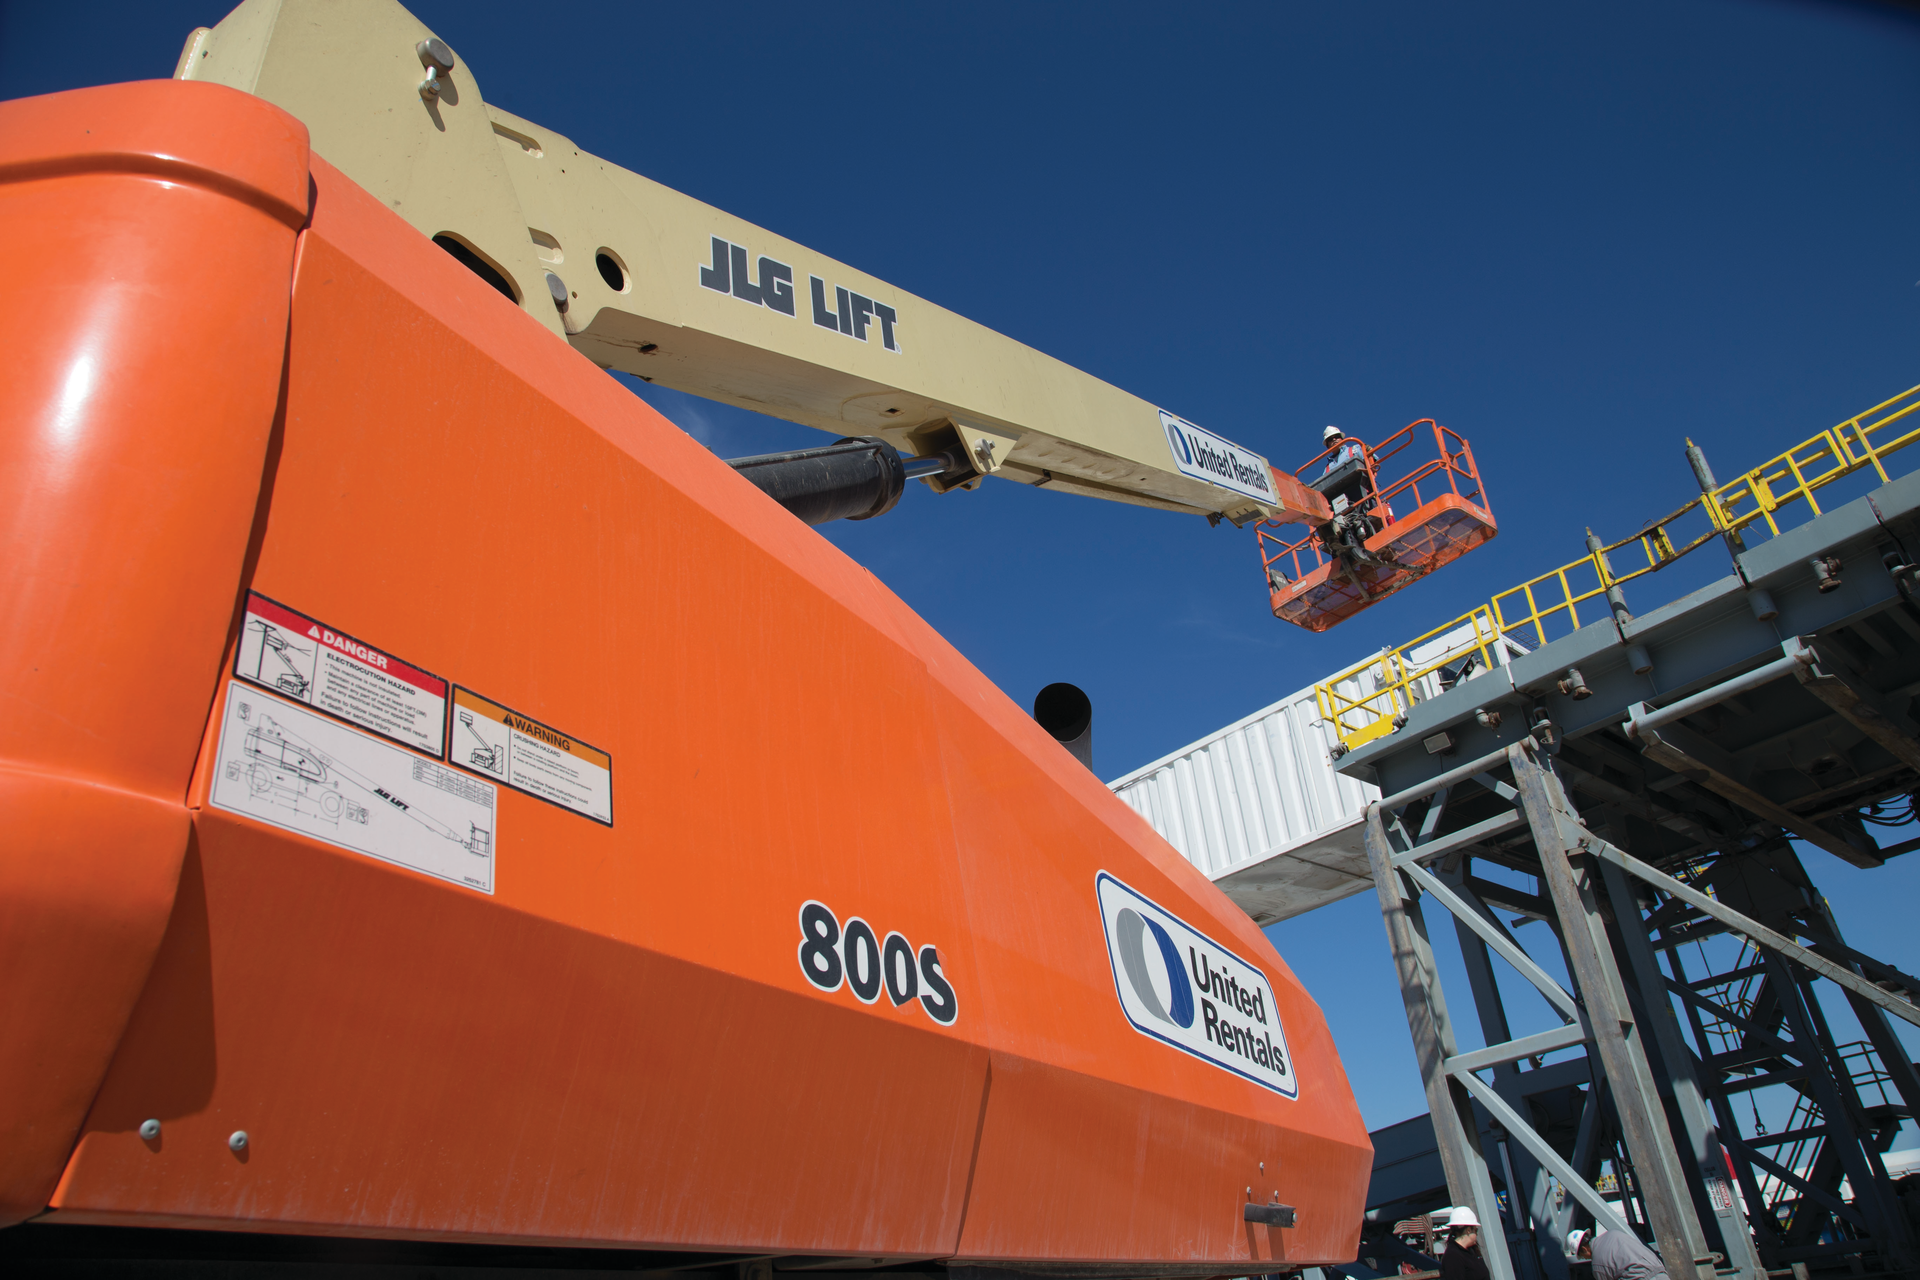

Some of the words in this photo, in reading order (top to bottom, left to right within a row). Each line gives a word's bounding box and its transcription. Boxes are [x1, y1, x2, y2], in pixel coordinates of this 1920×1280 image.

[699, 233, 796, 319] JLG
[809, 273, 898, 353] LIFT
[1187, 433, 1234, 480] United
[1229, 451, 1269, 493] Rentals
[323, 630, 387, 670] DANGER
[327, 652, 386, 683] ELECTROCUTION
[388, 679, 416, 696] HAZARD
[321, 691, 341, 704] Failure
[350, 703, 368, 715] follow
[368, 710, 401, 729] instructions
[402, 725, 411, 733] will
[412, 729, 428, 740] result
[327, 702, 344, 713] death
[353, 713, 374, 725] serious
[375, 721, 393, 734] injury.
[515, 717, 570, 752] WARNING
[514, 733, 539, 749] CRUSHING
[540, 744, 560, 758] HAZARD
[374, 788, 391, 799] JLG
[391, 797, 409, 811] LIFT
[799, 901, 957, 1026] 800S
[1189, 946, 1267, 1026] United
[1201, 998, 1287, 1077] Rentals
